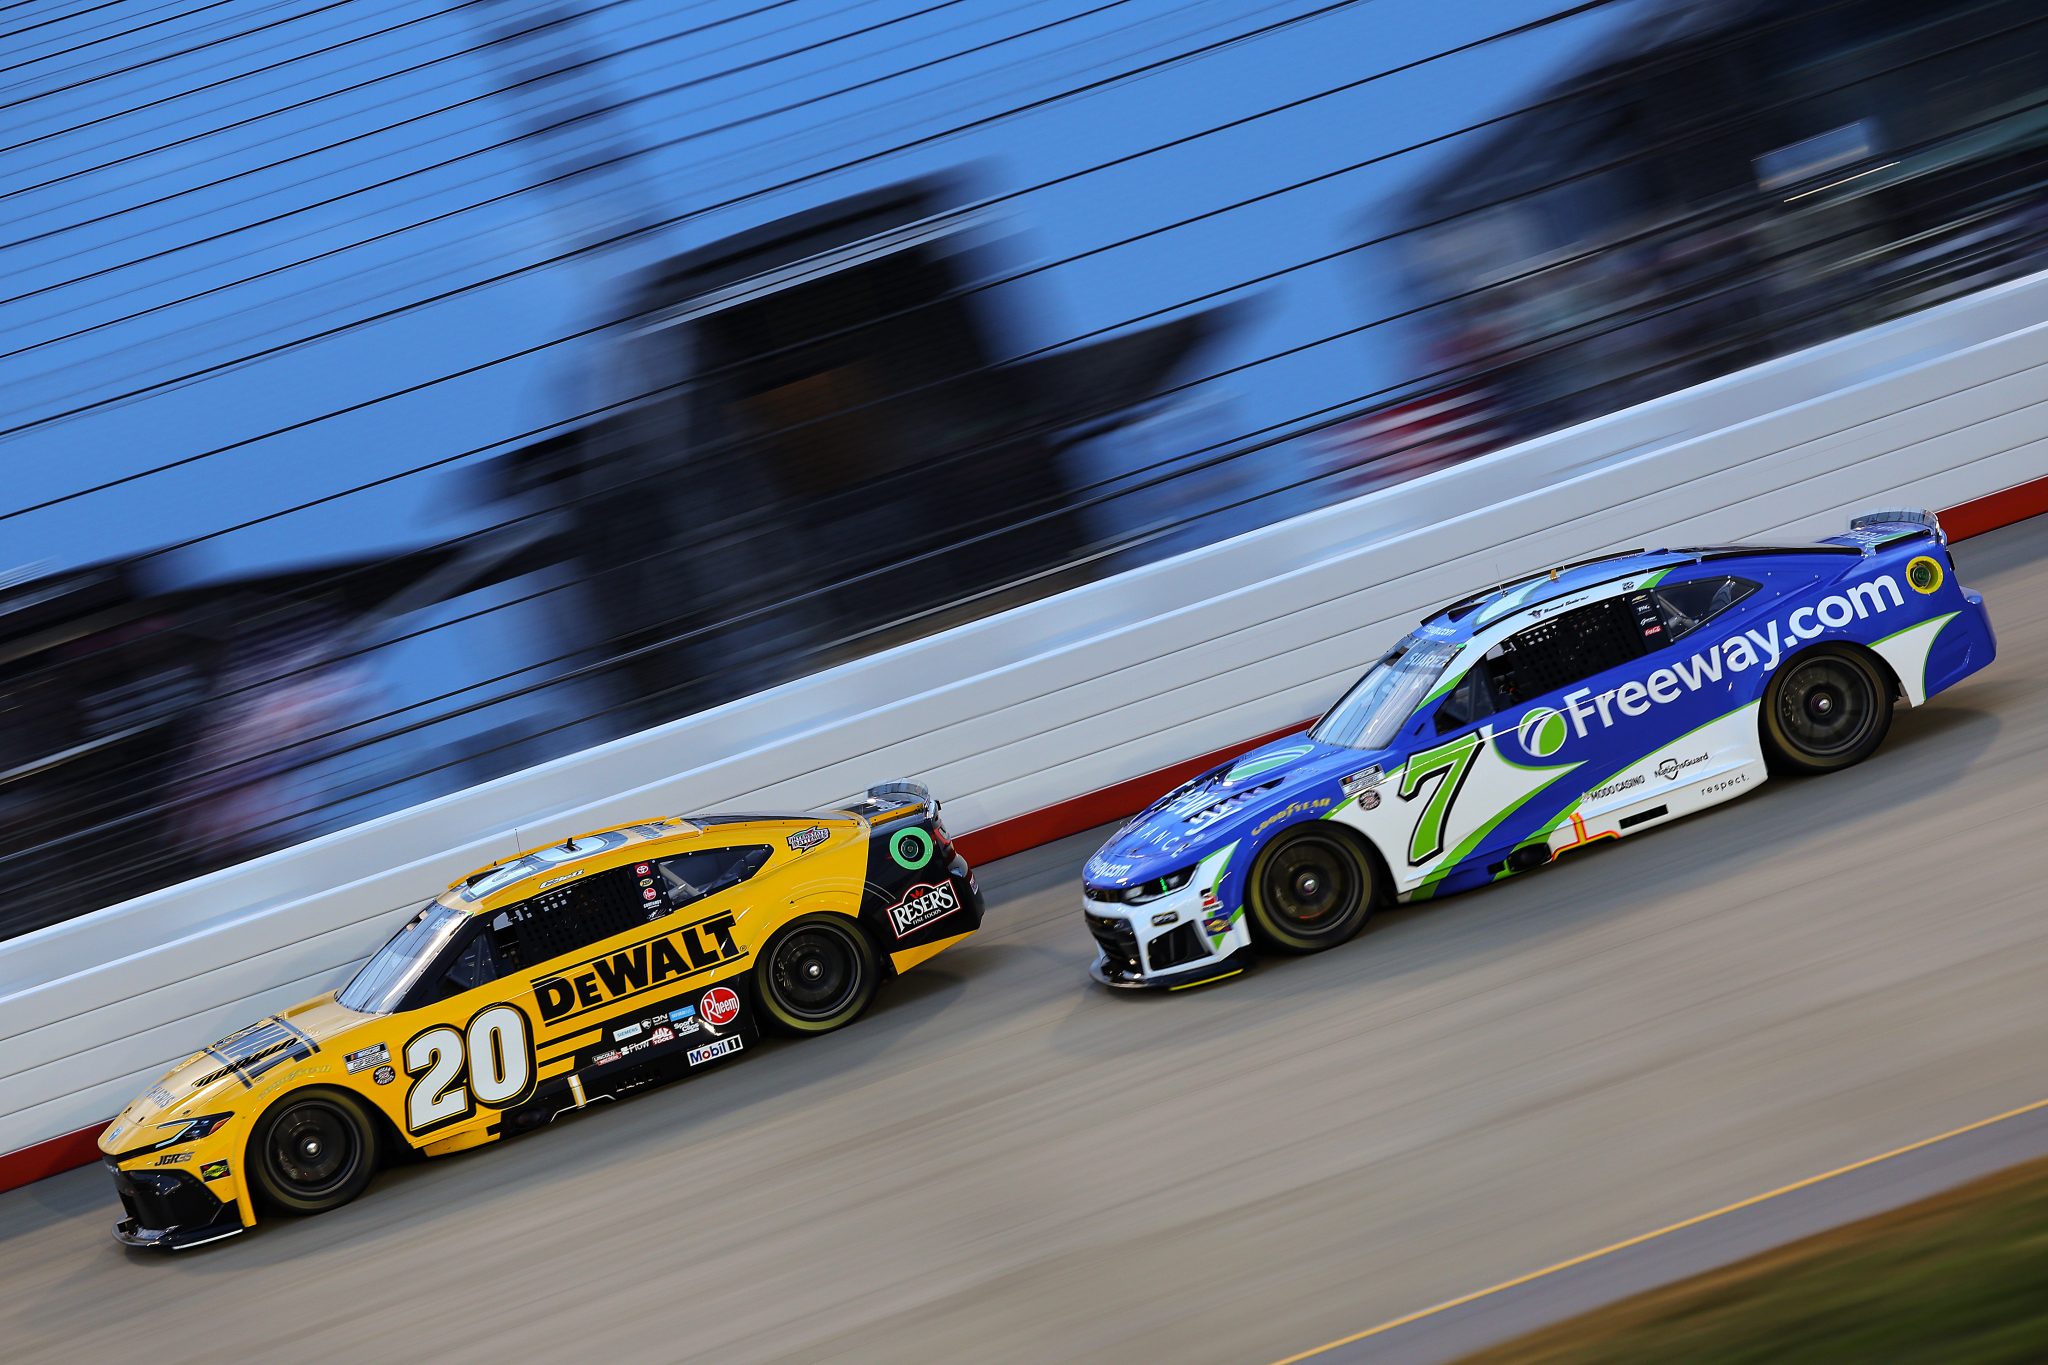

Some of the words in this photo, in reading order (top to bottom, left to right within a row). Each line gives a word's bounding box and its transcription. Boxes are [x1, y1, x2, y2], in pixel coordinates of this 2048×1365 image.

[1563, 574, 1905, 740] Freeway.com
[1655, 752, 1709, 778] NationsGuard
[1398, 728, 1486, 867] 7
[893, 886, 954, 933] RESER'S
[704, 991, 738, 1021] Rheem
[403, 1002, 537, 1137] 20
[689, 1042, 727, 1063] Mobil
[730, 1038, 737, 1049] 1
